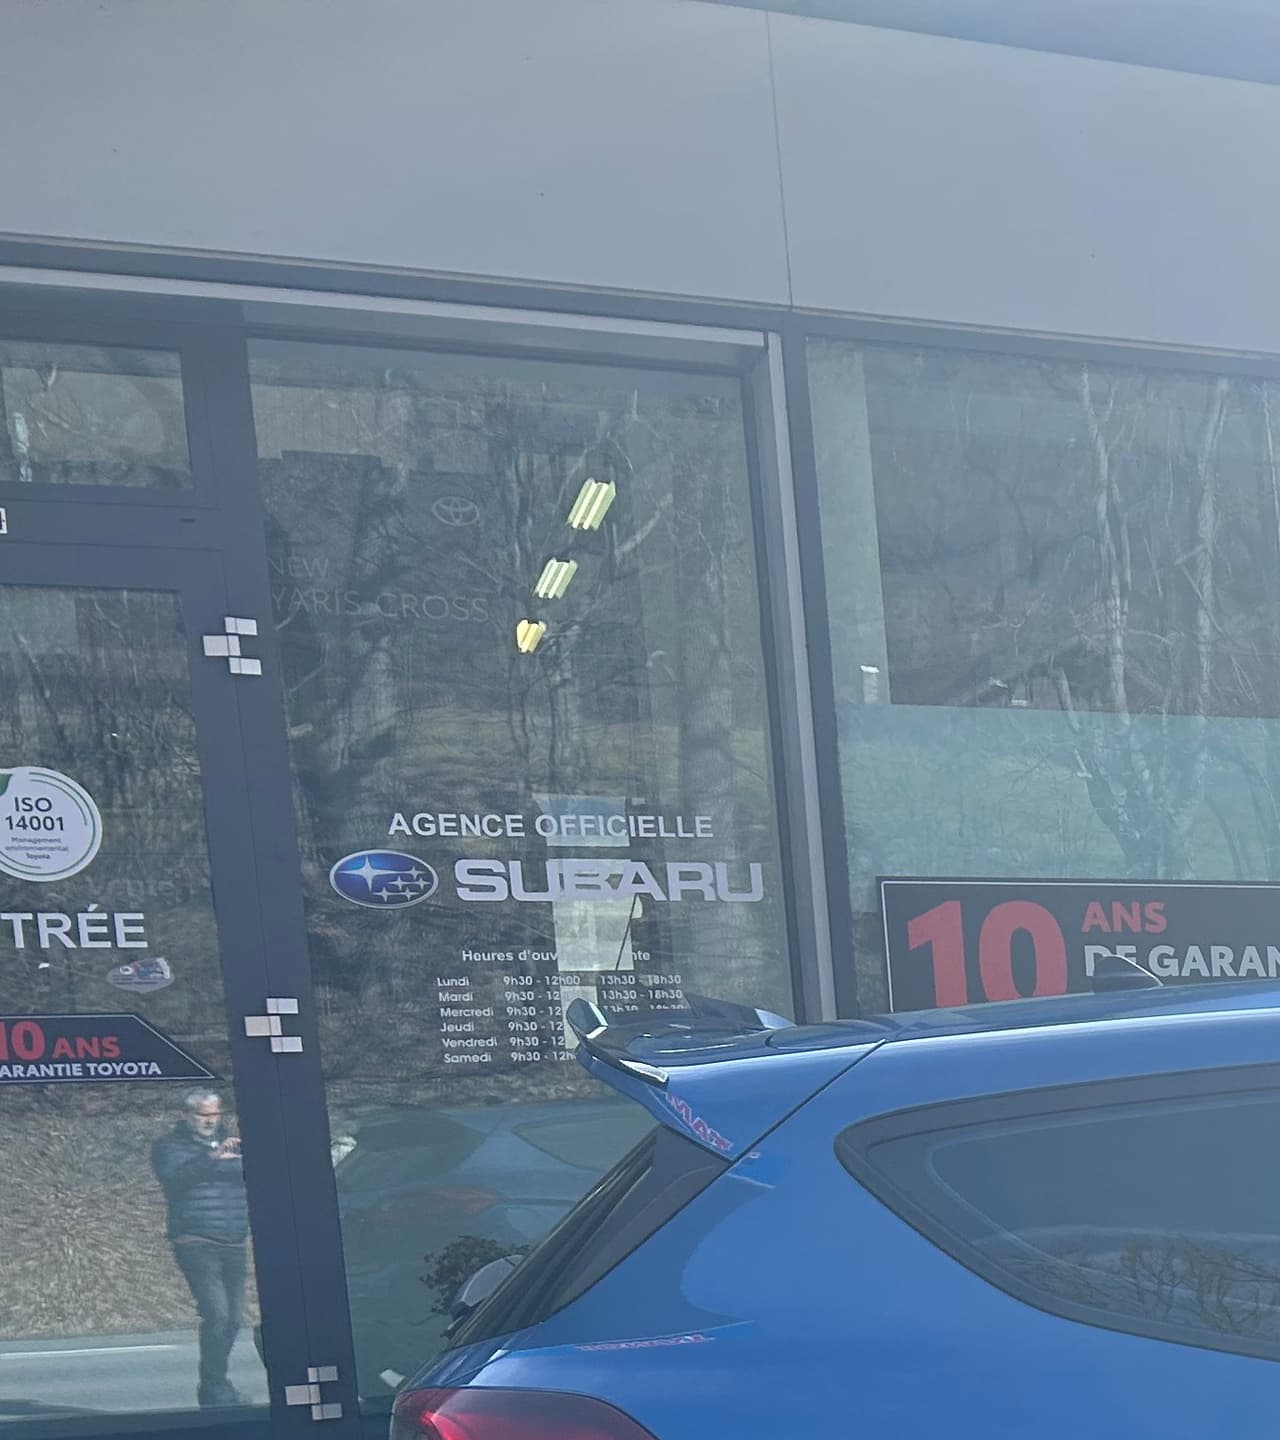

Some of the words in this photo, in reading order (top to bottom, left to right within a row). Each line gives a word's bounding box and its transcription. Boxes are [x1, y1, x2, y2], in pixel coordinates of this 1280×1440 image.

[375, 593, 489, 622] CROSS
[14, 797, 52, 812] ISO
[5, 815, 65, 831] 14001
[388, 813, 525, 838] AGENCE
[535, 814, 714, 838] OFFICIELLE
[454, 858, 763, 902] SUBARU
[0, 904, 148, 948] TRÉE
[462, 950, 513, 961] Heures
[907, 900, 1068, 1007] 10
[1081, 901, 1167, 933] ANS
[437, 977, 469, 987] Lundi
[504, 976, 532, 986] 9h30
[600, 975, 635, 985] 13h30
[439, 992, 473, 1001] Mardi
[505, 991, 534, 1001] 9h30
[602, 990, 636, 1000] 13h30
[440, 1007, 494, 1017] Mercredi
[507, 1007, 536, 1016] 9h30
[440, 1022, 474, 1032] Jeudi
[508, 1022, 537, 1031] 9h30
[52, 1037, 121, 1059] ANS
[442, 1037, 497, 1047] Vendredi
[510, 1037, 539, 1046] 9h30
[444, 1052, 492, 1063] Samedi
[511, 1052, 541, 1061] 9h30
[0, 1063, 83, 1079] ARANTIE
[86, 1062, 162, 1076] TOYOTA
